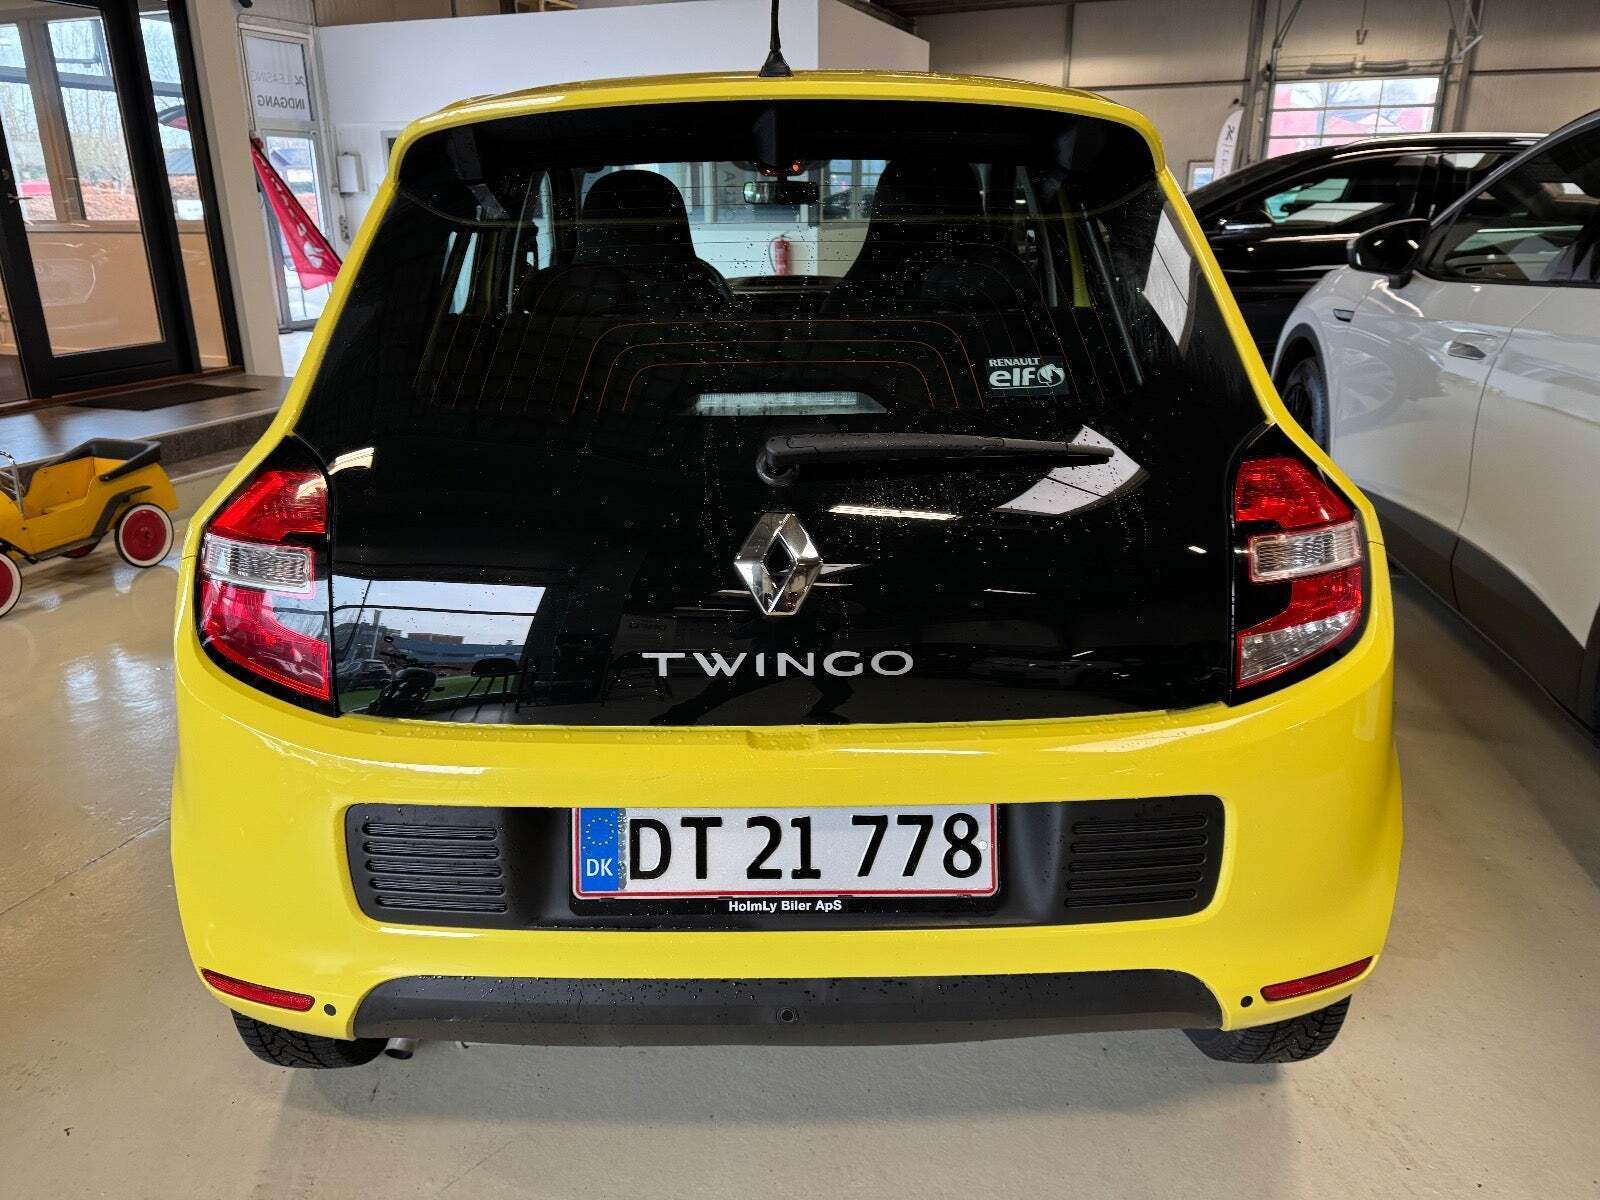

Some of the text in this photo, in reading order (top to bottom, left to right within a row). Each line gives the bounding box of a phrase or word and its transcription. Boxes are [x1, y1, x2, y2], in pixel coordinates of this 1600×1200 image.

[988, 357, 1041, 368] RENAULT
[989, 367, 1037, 387] elf
[641, 650, 914, 677] TWINGO
[629, 812, 983, 880] DT 21 778
[586, 858, 614, 877] DK
[728, 899, 843, 913] HolmLy Biler ApS
